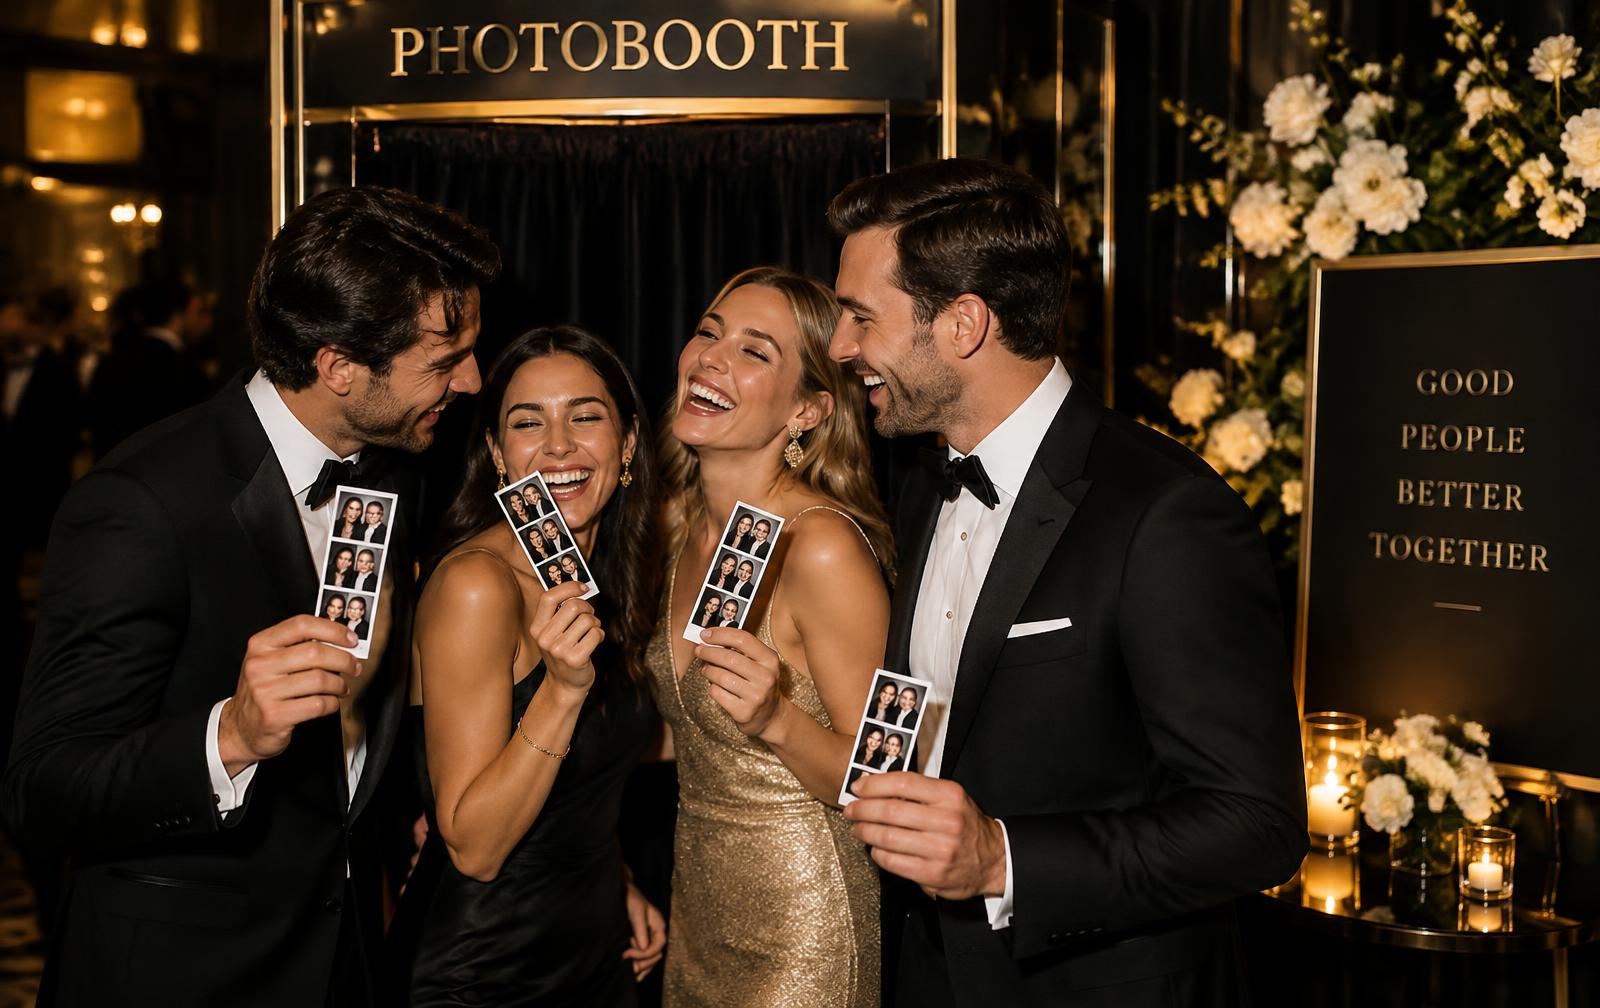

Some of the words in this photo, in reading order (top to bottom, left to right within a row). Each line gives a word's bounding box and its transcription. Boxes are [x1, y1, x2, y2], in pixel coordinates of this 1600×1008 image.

[391, 18, 849, 77] PHOTOBOOTH
[1416, 368, 1514, 396] GOOD
[1400, 423, 1526, 454] PEOPLE
[1397, 478, 1525, 512] BETTER
[1368, 531, 1550, 573] TOGETHER
